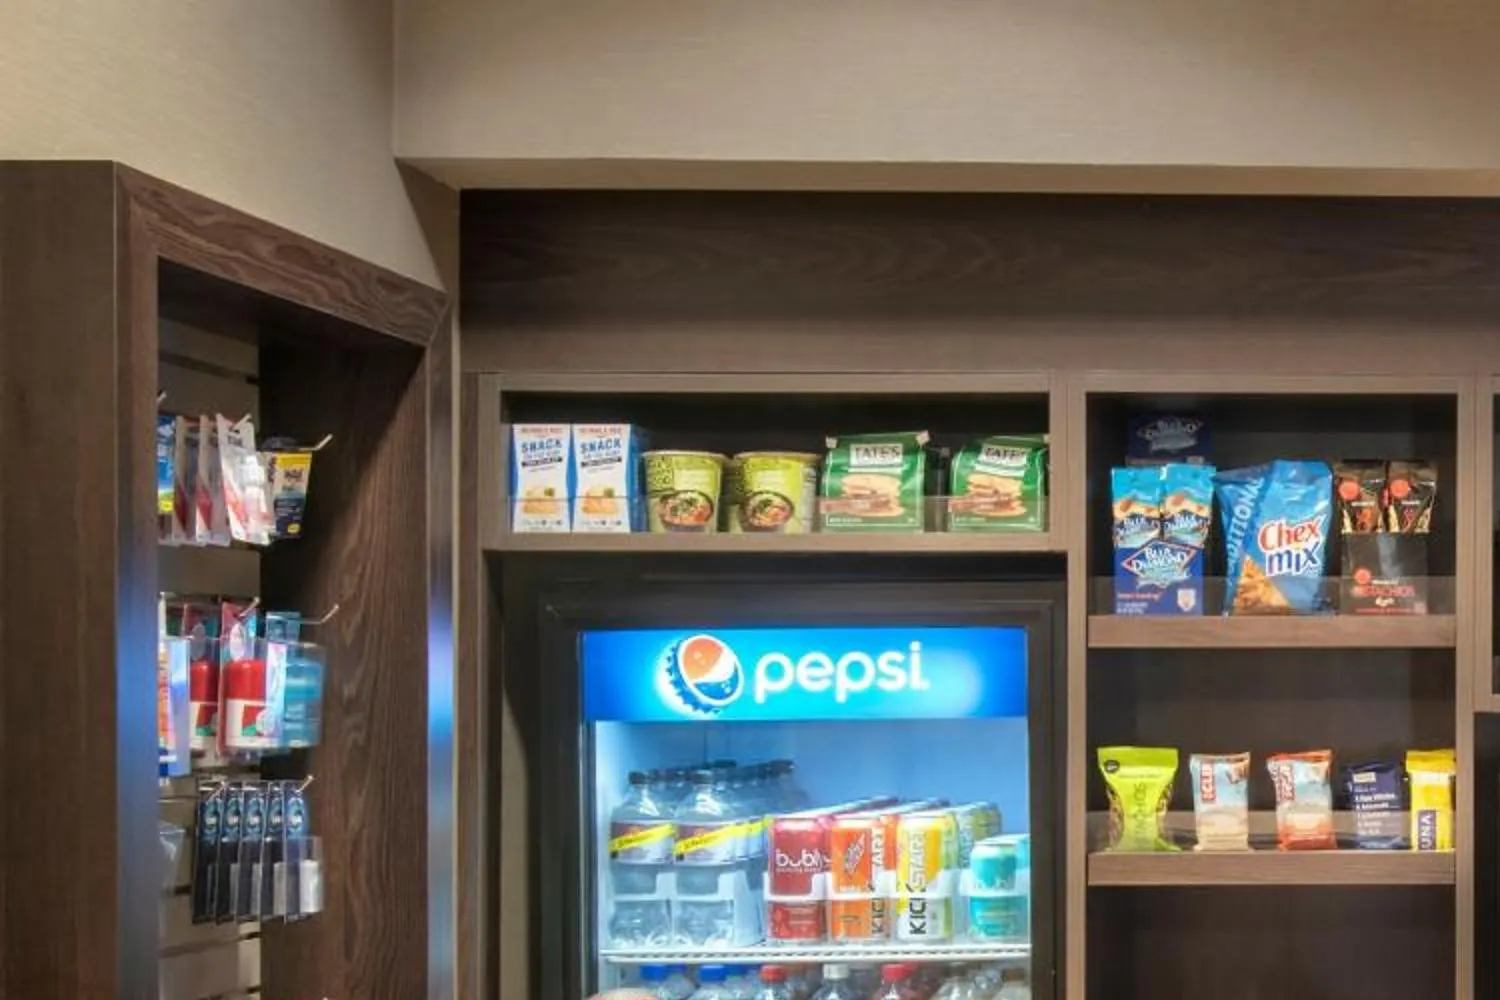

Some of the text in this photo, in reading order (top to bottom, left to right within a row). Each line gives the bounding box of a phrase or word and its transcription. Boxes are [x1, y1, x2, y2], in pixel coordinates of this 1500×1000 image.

[1257, 514, 1326, 551] Chex
[1265, 544, 1323, 577] mix
[753, 640, 930, 704] pepsi
